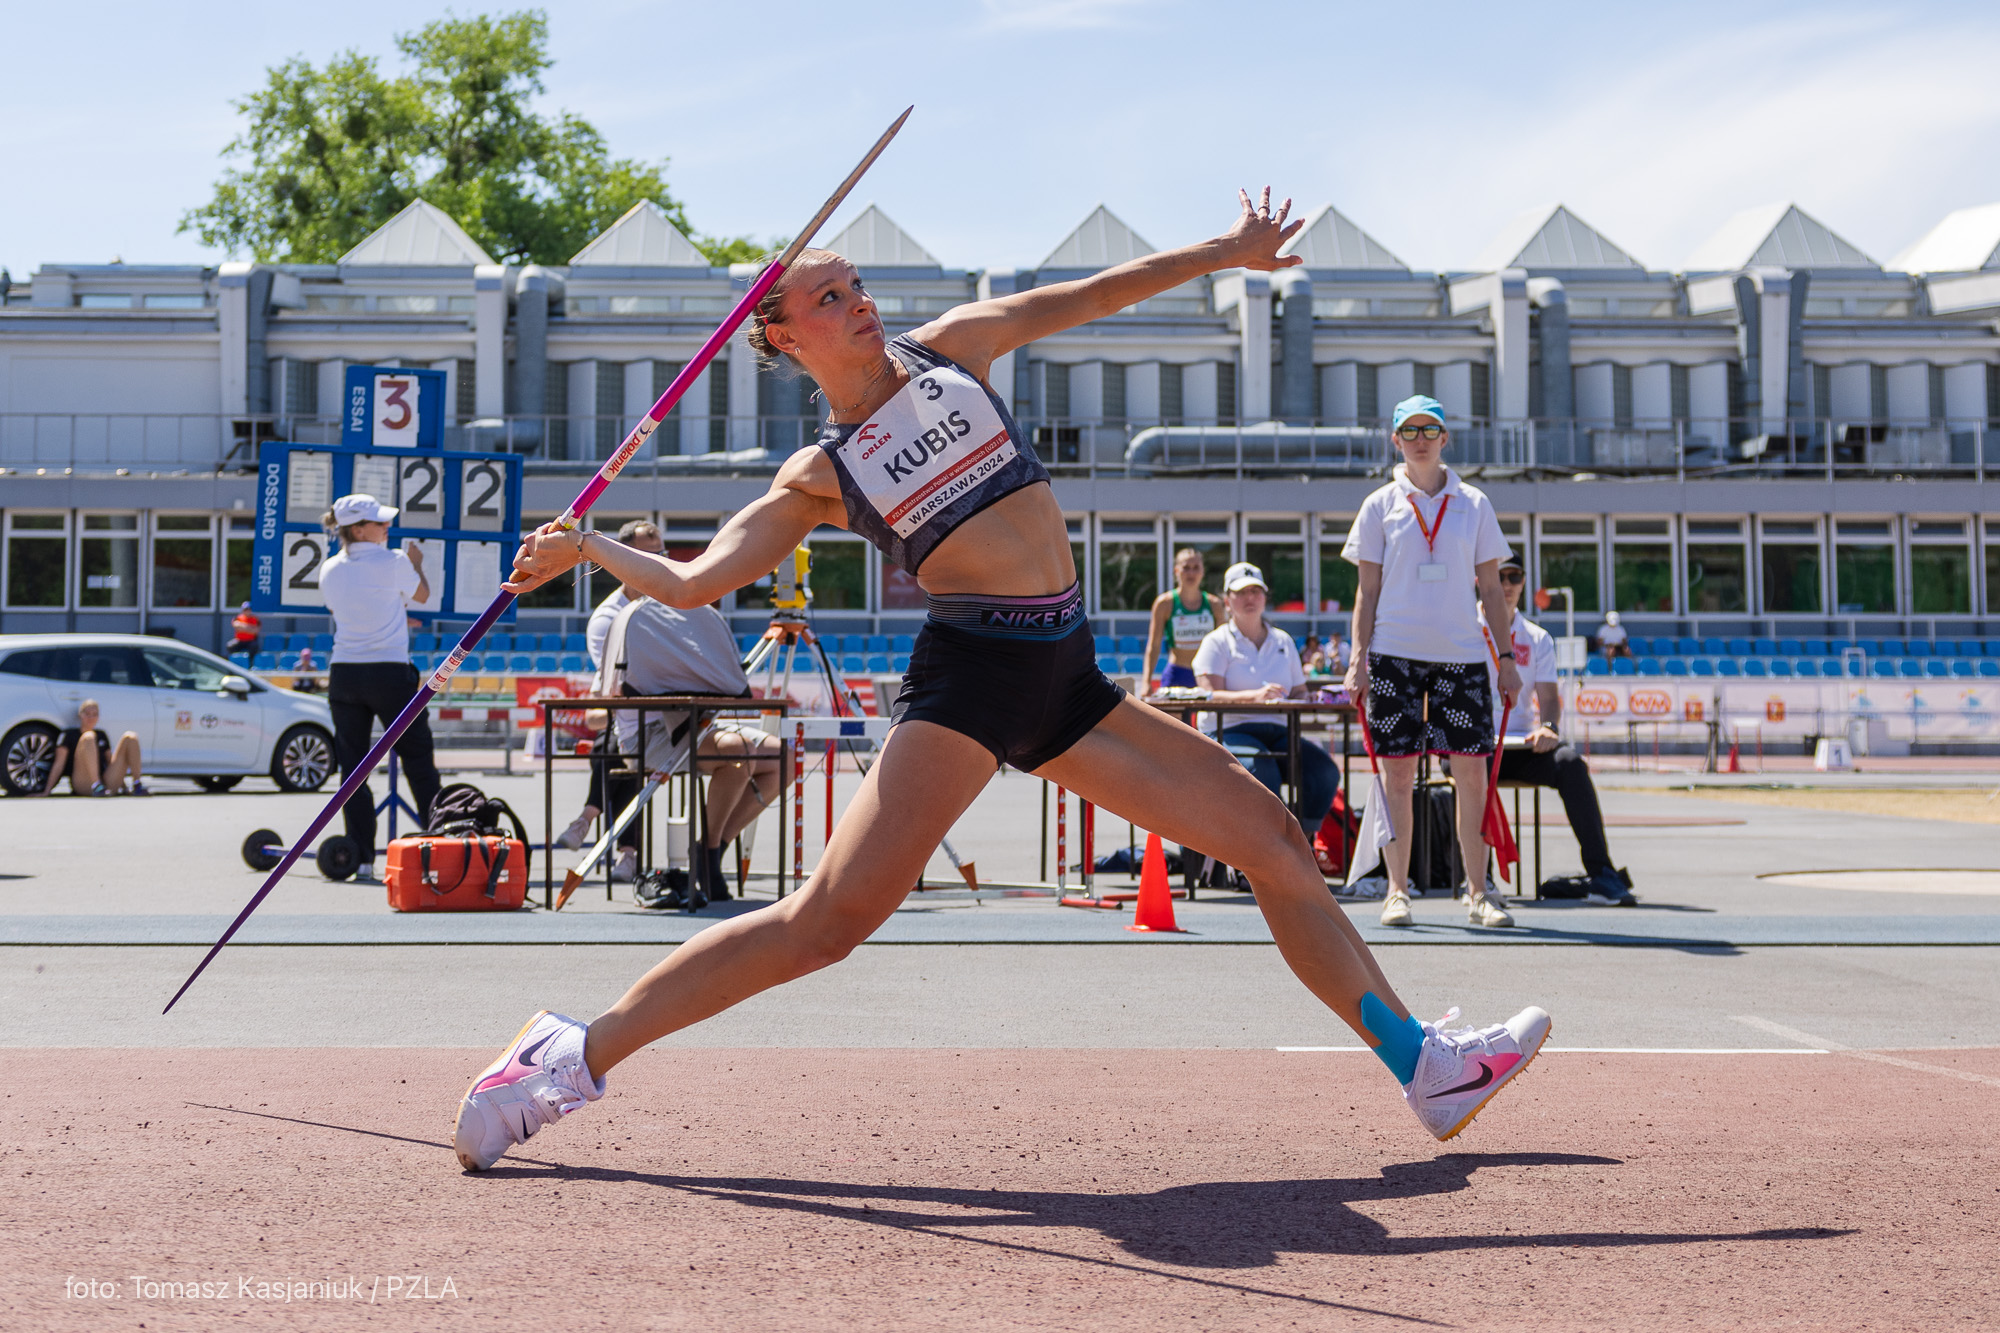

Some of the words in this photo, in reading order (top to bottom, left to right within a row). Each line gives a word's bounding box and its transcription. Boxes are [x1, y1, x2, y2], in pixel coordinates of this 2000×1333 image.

[350, 386, 366, 432] ESSAI
[380, 380, 413, 430] 3
[919, 377, 944, 401] 3
[608, 433, 641, 474] polanik
[862, 432, 892, 460] ORLEN
[882, 410, 971, 485] KUBIS
[261, 463, 281, 540] DOSSARD
[402, 460, 439, 512] 2
[465, 464, 501, 517] 2
[902, 485, 934, 510] Mistrzostwa
[932, 474, 949, 488] Polski
[908, 473, 978, 525] WARSZAWA
[977, 453, 1004, 477] 2024
[257, 555, 273, 595] PERF
[288, 539, 322, 590] 2
[987, 611, 1057, 628] NIKE
[1060, 597, 1083, 625] PRO
